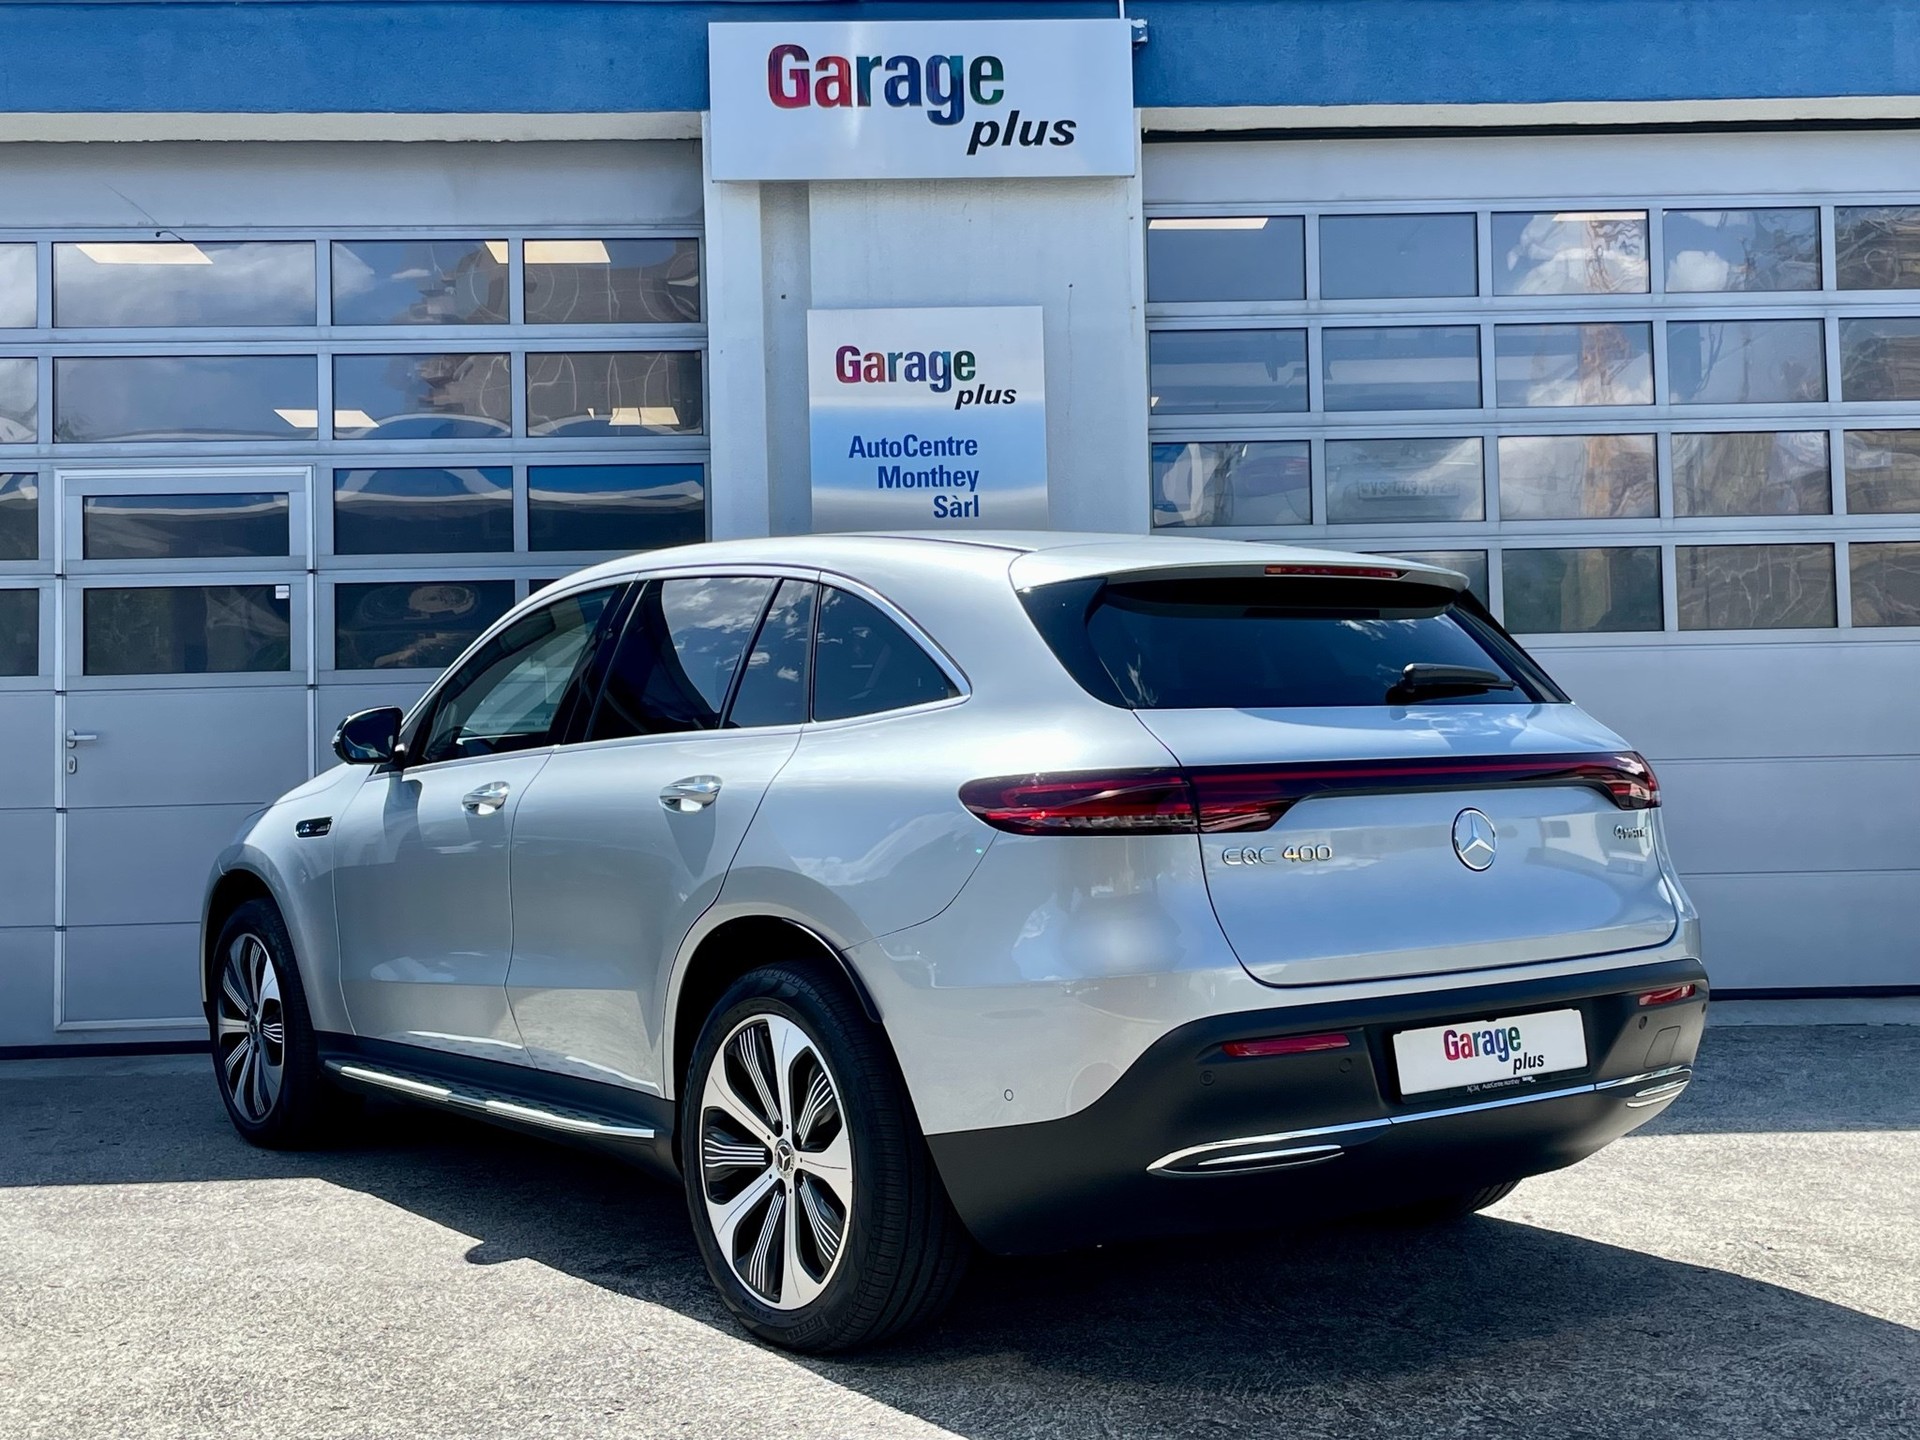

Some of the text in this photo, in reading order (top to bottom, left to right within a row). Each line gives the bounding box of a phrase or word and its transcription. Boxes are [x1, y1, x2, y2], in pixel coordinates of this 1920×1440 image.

[767, 43, 1005, 126] Garage
[966, 110, 1077, 156] plus
[835, 345, 976, 393] Garage
[954, 384, 1017, 410] plus
[848, 434, 978, 458] AutoCentre
[877, 465, 979, 492] Monthey
[933, 495, 979, 518] Sàrl
[1221, 843, 1333, 866] EQC 400
[1443, 1026, 1521, 1062] Garage
[1513, 1052, 1545, 1074] plus
